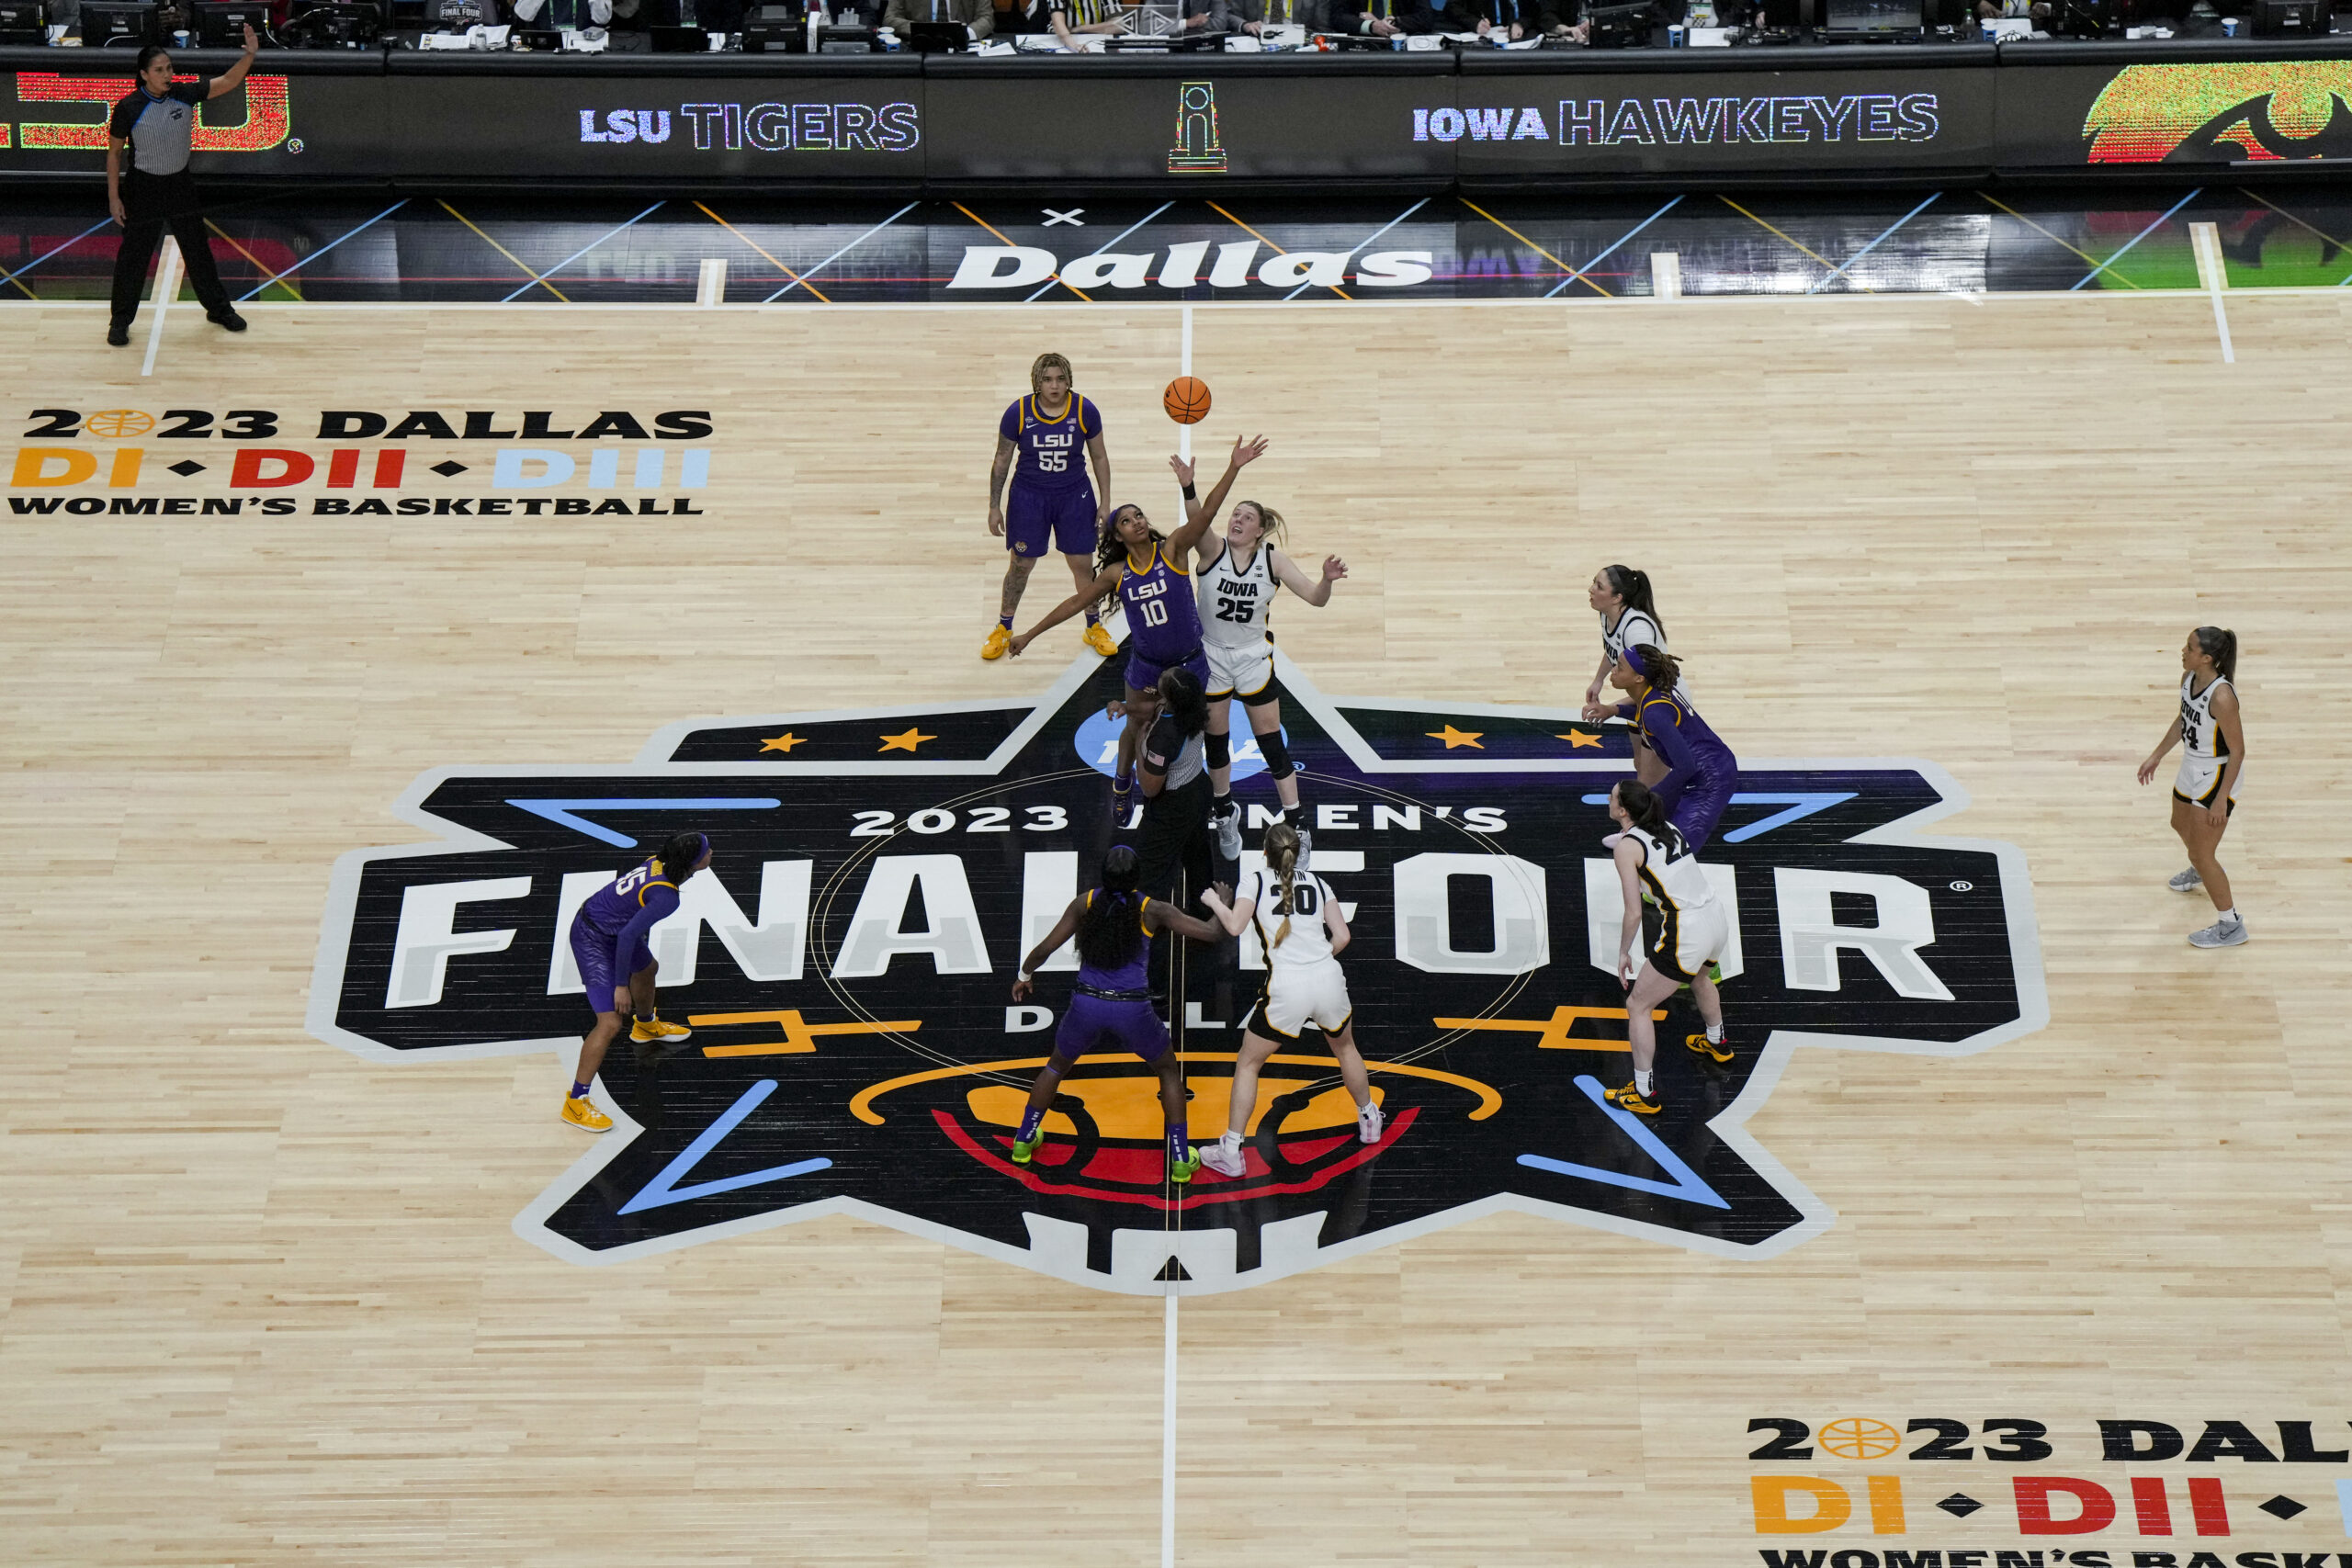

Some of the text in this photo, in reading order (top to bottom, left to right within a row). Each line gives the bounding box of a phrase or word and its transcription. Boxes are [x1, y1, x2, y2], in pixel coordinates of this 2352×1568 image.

[441, 7, 481, 17] FINAL FOUR
[580, 103, 920, 151] LSU TIGERS
[1413, 93, 1939, 146] IOWA HAWKEYES
[945, 240, 1432, 288] Dallas
[315, 410, 713, 439] DALLAS
[1033, 434, 1072, 447] LSU
[11, 447, 711, 488] DI DII DIII
[1038, 451, 1069, 471] 55
[7, 497, 704, 515] WOMEN'S BASKETBALL
[1128, 579, 1168, 601] LSU
[1216, 578, 1258, 596] IOWA
[1140, 599, 1168, 626] 10
[1216, 597, 1255, 624] 25
[850, 806, 1068, 836] 2023
[1652, 828, 1690, 865] 22
[1273, 870, 1307, 881] MTIN
[1270, 885, 1317, 915] 20
[2097, 1419, 2352, 1462] DAL
[1750, 1475, 2231, 1537] DI DII
